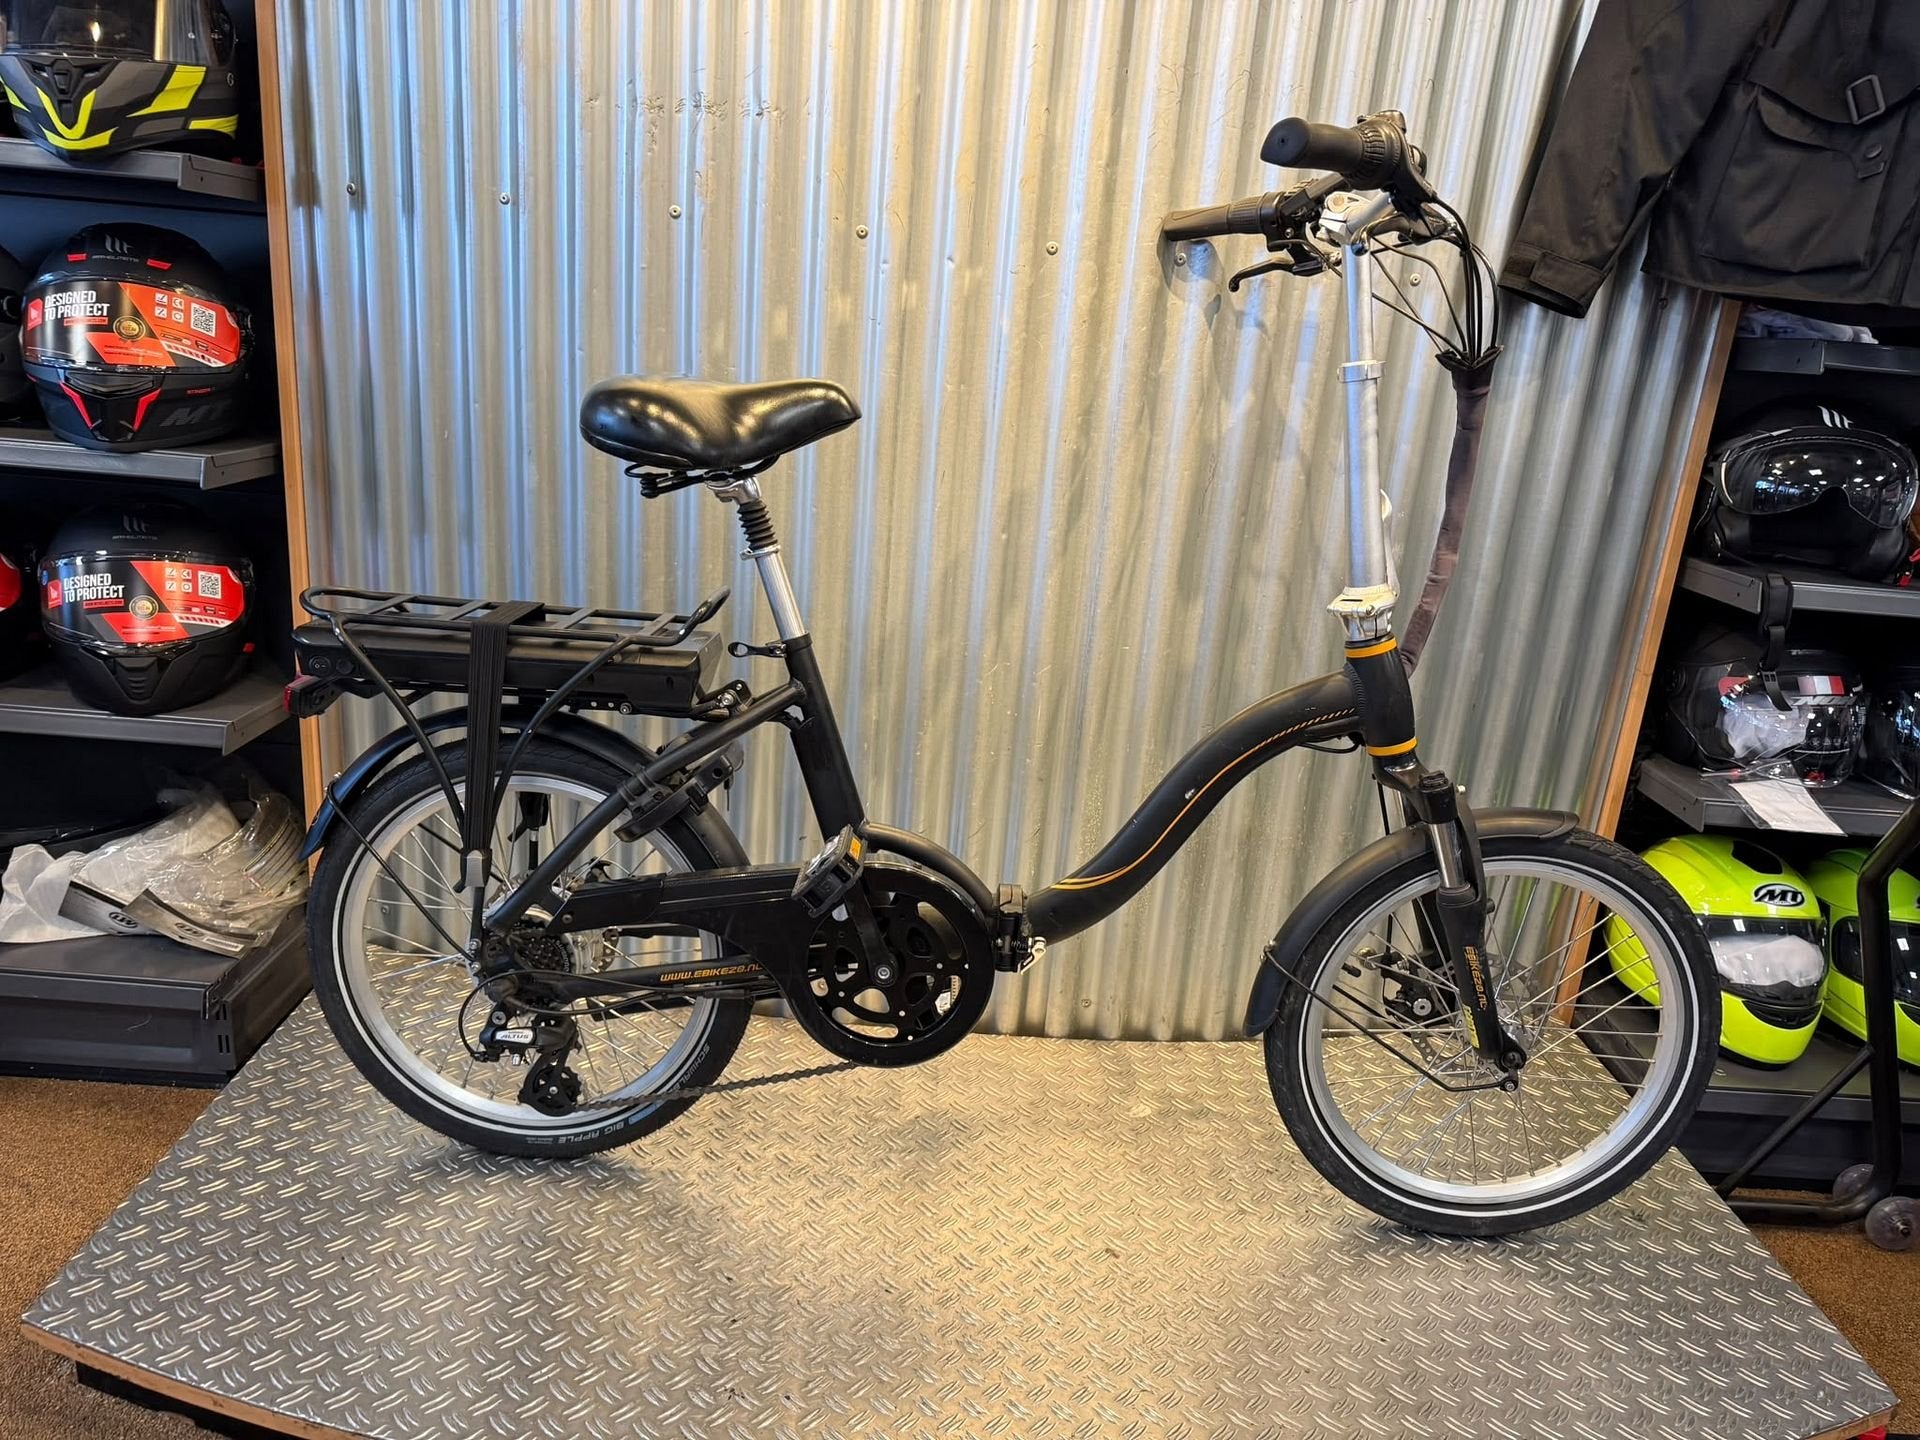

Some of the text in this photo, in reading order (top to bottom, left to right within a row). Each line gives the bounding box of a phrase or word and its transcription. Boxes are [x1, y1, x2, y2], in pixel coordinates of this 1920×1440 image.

[45, 291, 96, 308] DESIGNED
[45, 304, 110, 321] TO PROTECT
[64, 573, 111, 590] DESIGNED
[64, 585, 125, 603] TO PROTECT
[558, 1130, 600, 1143] APPLE
[604, 1121, 625, 1136] BIG
